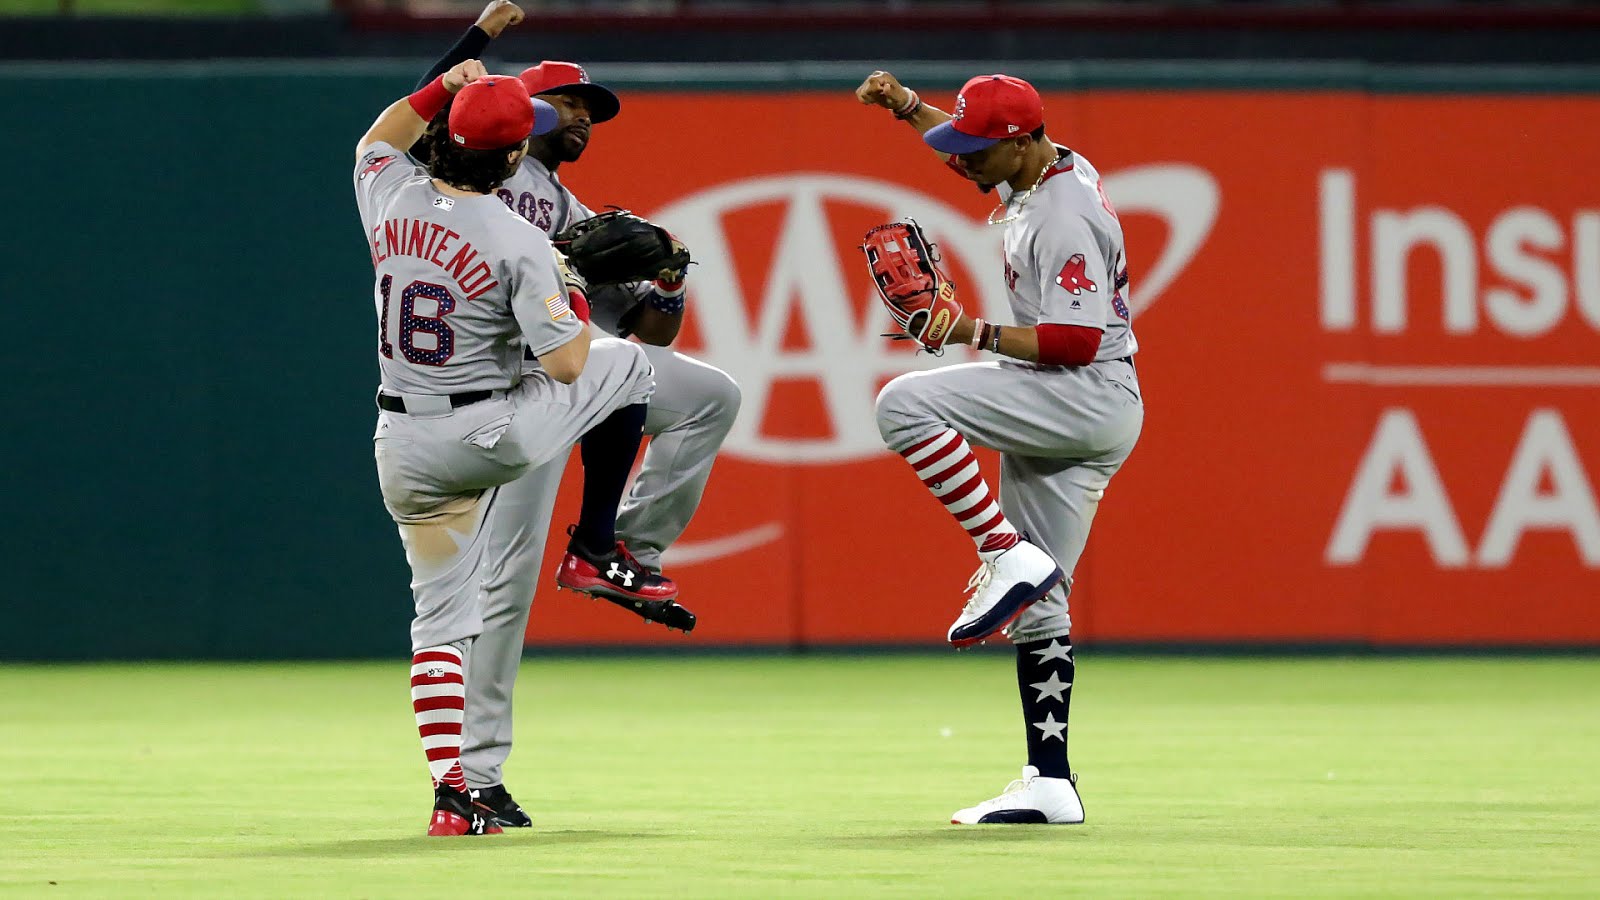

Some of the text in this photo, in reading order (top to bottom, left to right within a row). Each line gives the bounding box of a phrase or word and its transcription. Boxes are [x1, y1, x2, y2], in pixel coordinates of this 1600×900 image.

[370, 217, 499, 302] ENINTENDI
[1317, 167, 1600, 340] Ins
[930, 313, 948, 339] Wilson
